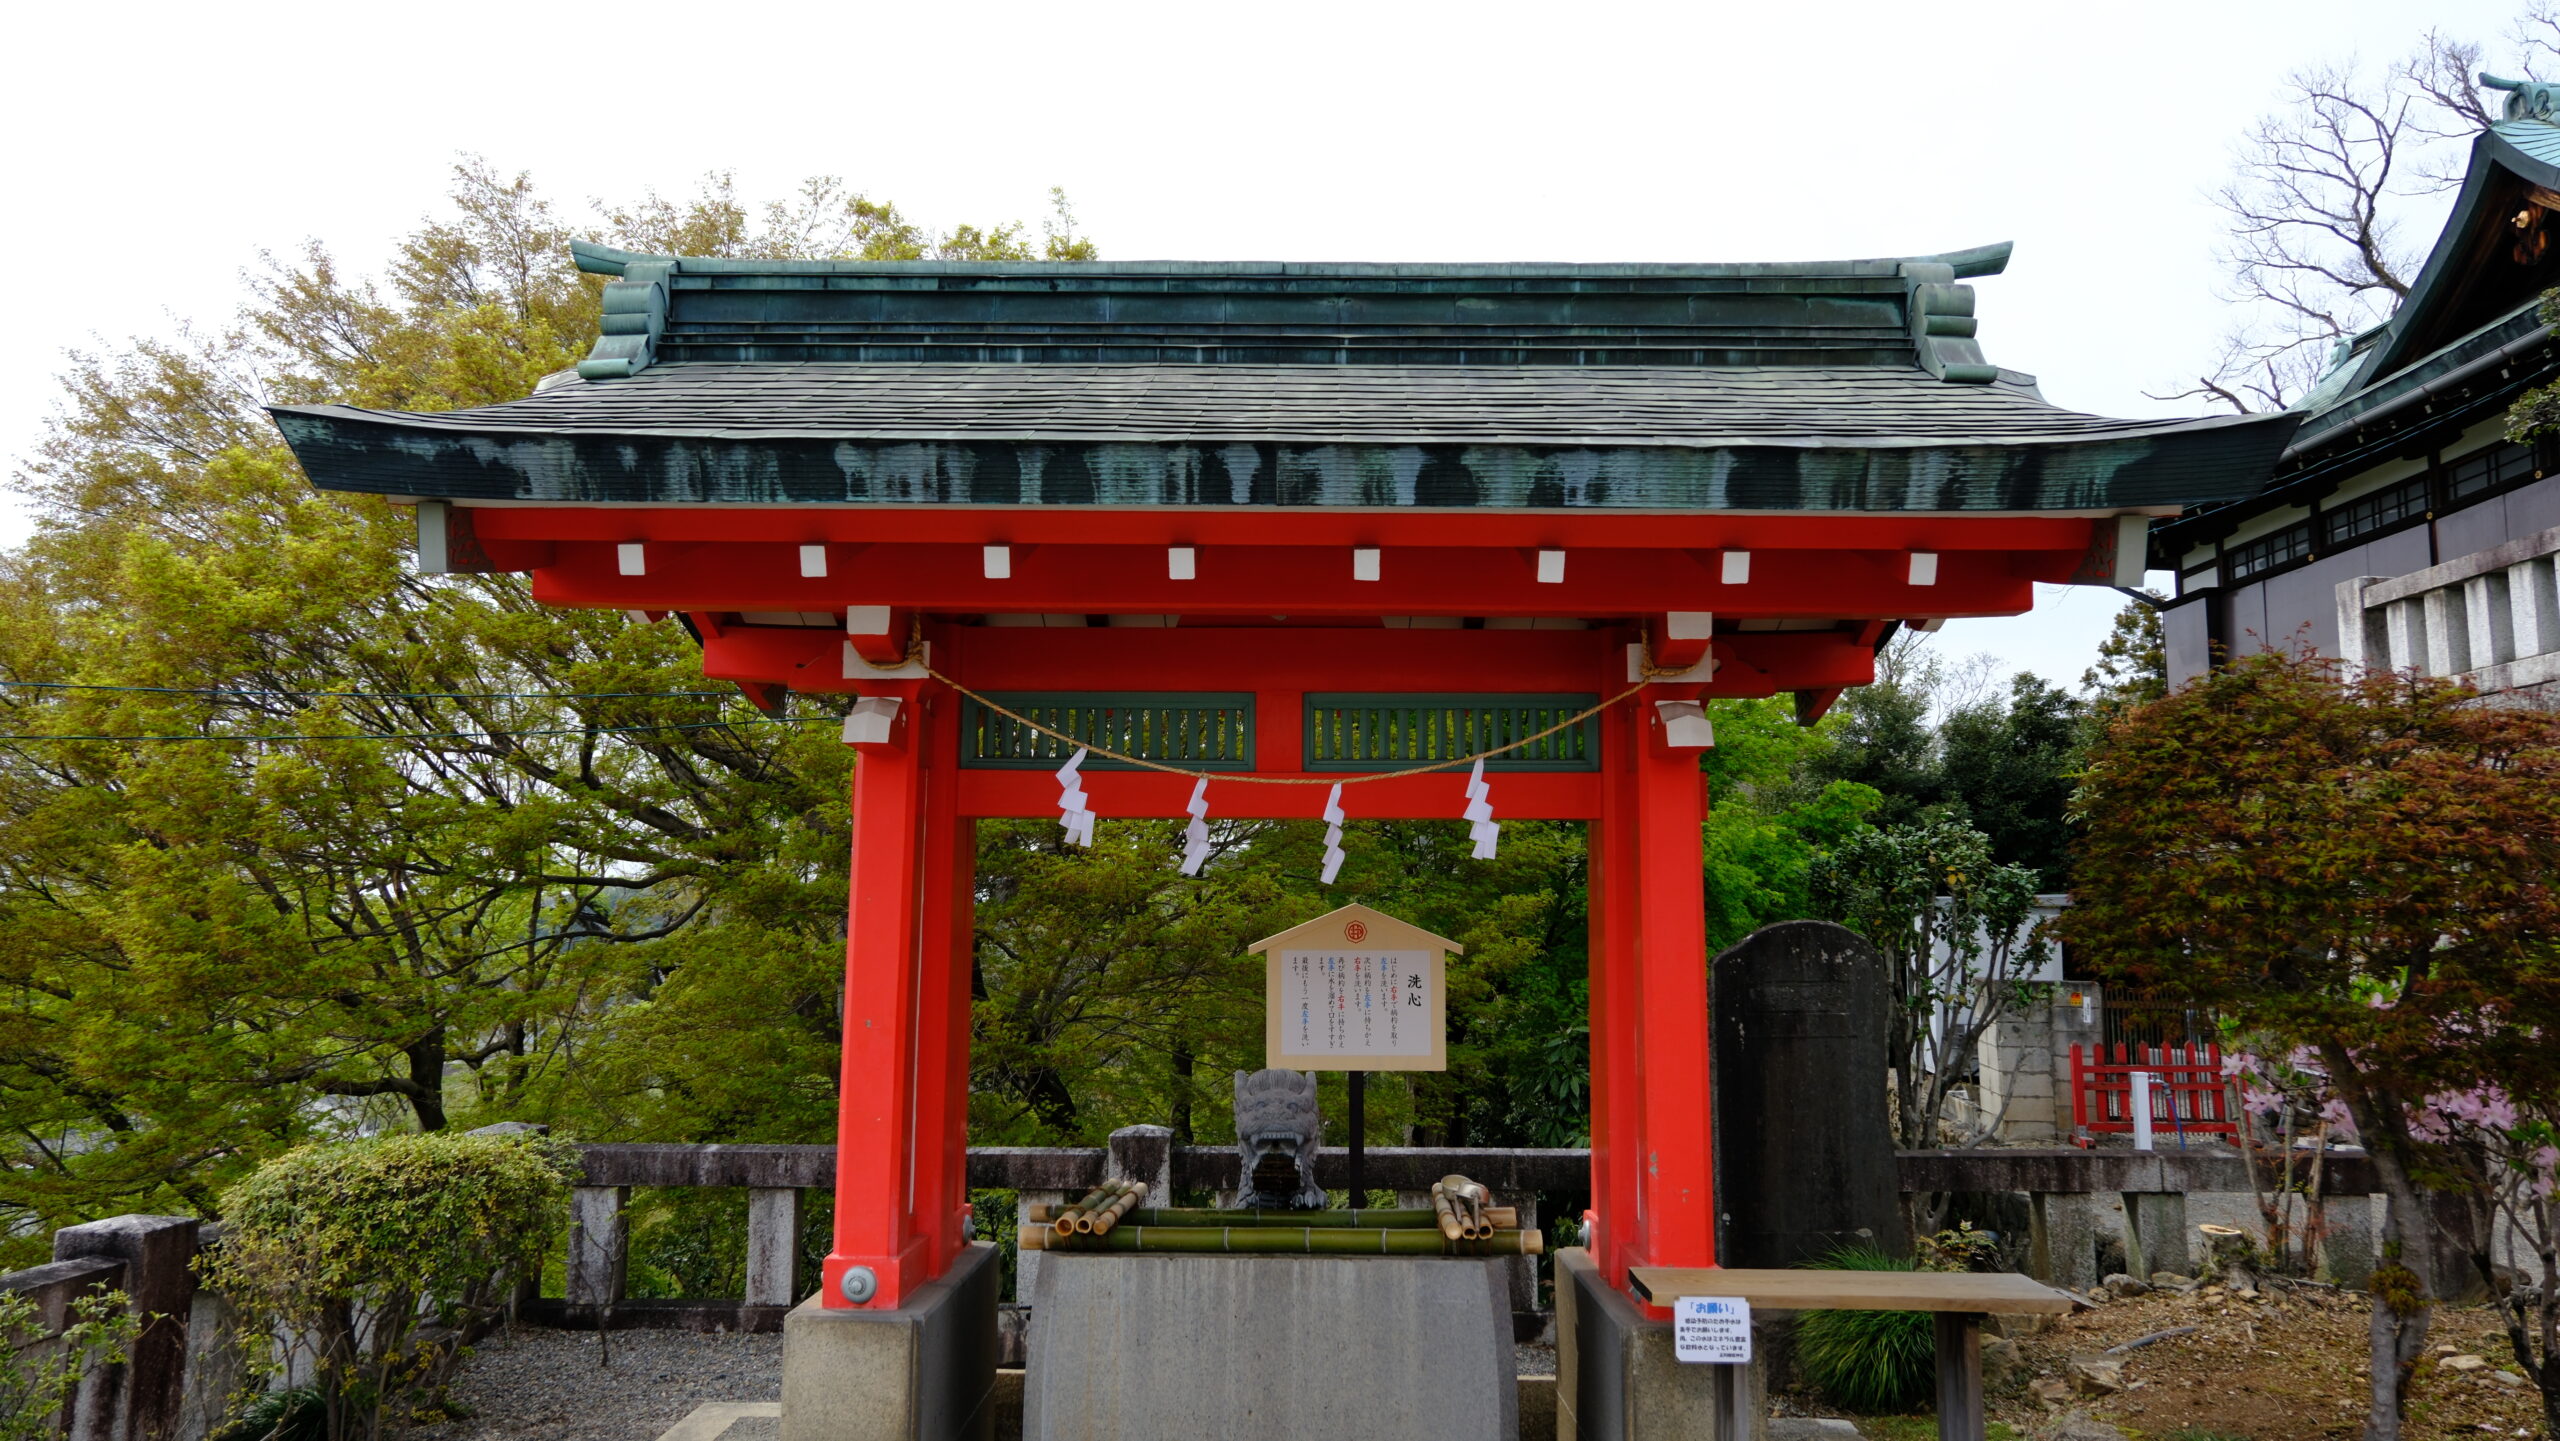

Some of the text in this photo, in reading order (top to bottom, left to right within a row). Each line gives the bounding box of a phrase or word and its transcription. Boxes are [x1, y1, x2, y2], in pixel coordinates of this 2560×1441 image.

[1354, 957, 1362, 1012] 右手を洗います。
[1380, 957, 1388, 1012] 左手を洗います。
[1408, 974, 1422, 1007] 洗心
